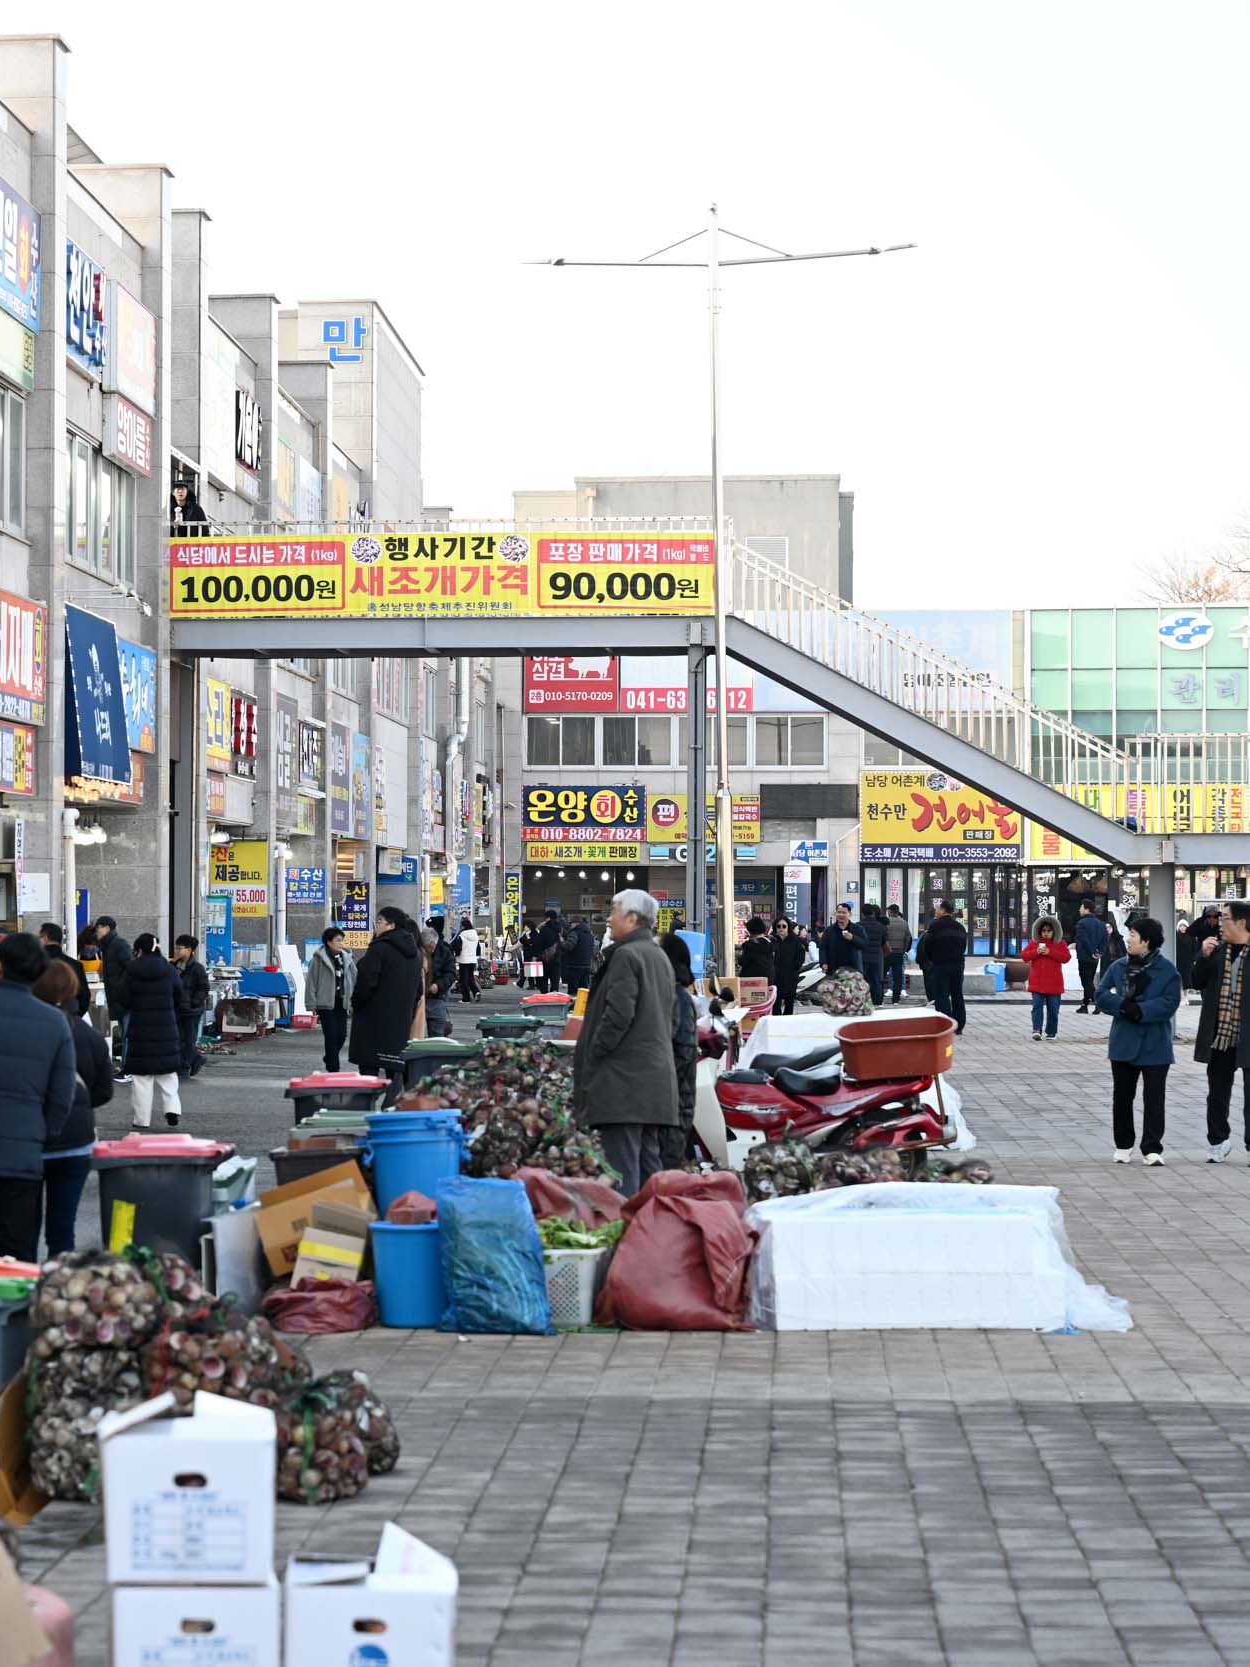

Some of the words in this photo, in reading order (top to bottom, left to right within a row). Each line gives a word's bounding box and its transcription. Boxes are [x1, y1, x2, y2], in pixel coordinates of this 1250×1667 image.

[322, 316, 366, 362] 만
[177, 544, 230, 564] 식당에서
[234, 544, 276, 563] 드시는
[280, 544, 306, 563] 가격
[311, 549, 337, 562] (1kg)
[385, 536, 496, 562] 행사기간
[549, 543, 583, 562] 포장
[588, 543, 658, 562] 판매가격
[662, 549, 686, 561] (1kg)
[181, 574, 336, 603] 100,000원
[350, 564, 527, 596] 새조개가격
[550, 571, 699, 604] 90,000원
[545, 690, 613, 702] 010-5170-0209
[865, 774, 888, 788] 남당
[891, 774, 926, 788] 어촌계
[527, 789, 588, 824] 온양
[596, 794, 617, 820] 회
[623, 789, 639, 824] 수산
[866, 803, 907, 821] 천수만
[540, 828, 642, 841] 010-8802-7824
[608, 846, 639, 859] 판매장
[900, 847, 934, 857] 전국택배
[941, 847, 1017, 857] 010-3553-2092
[215, 864, 263, 882] 제공합니다.
